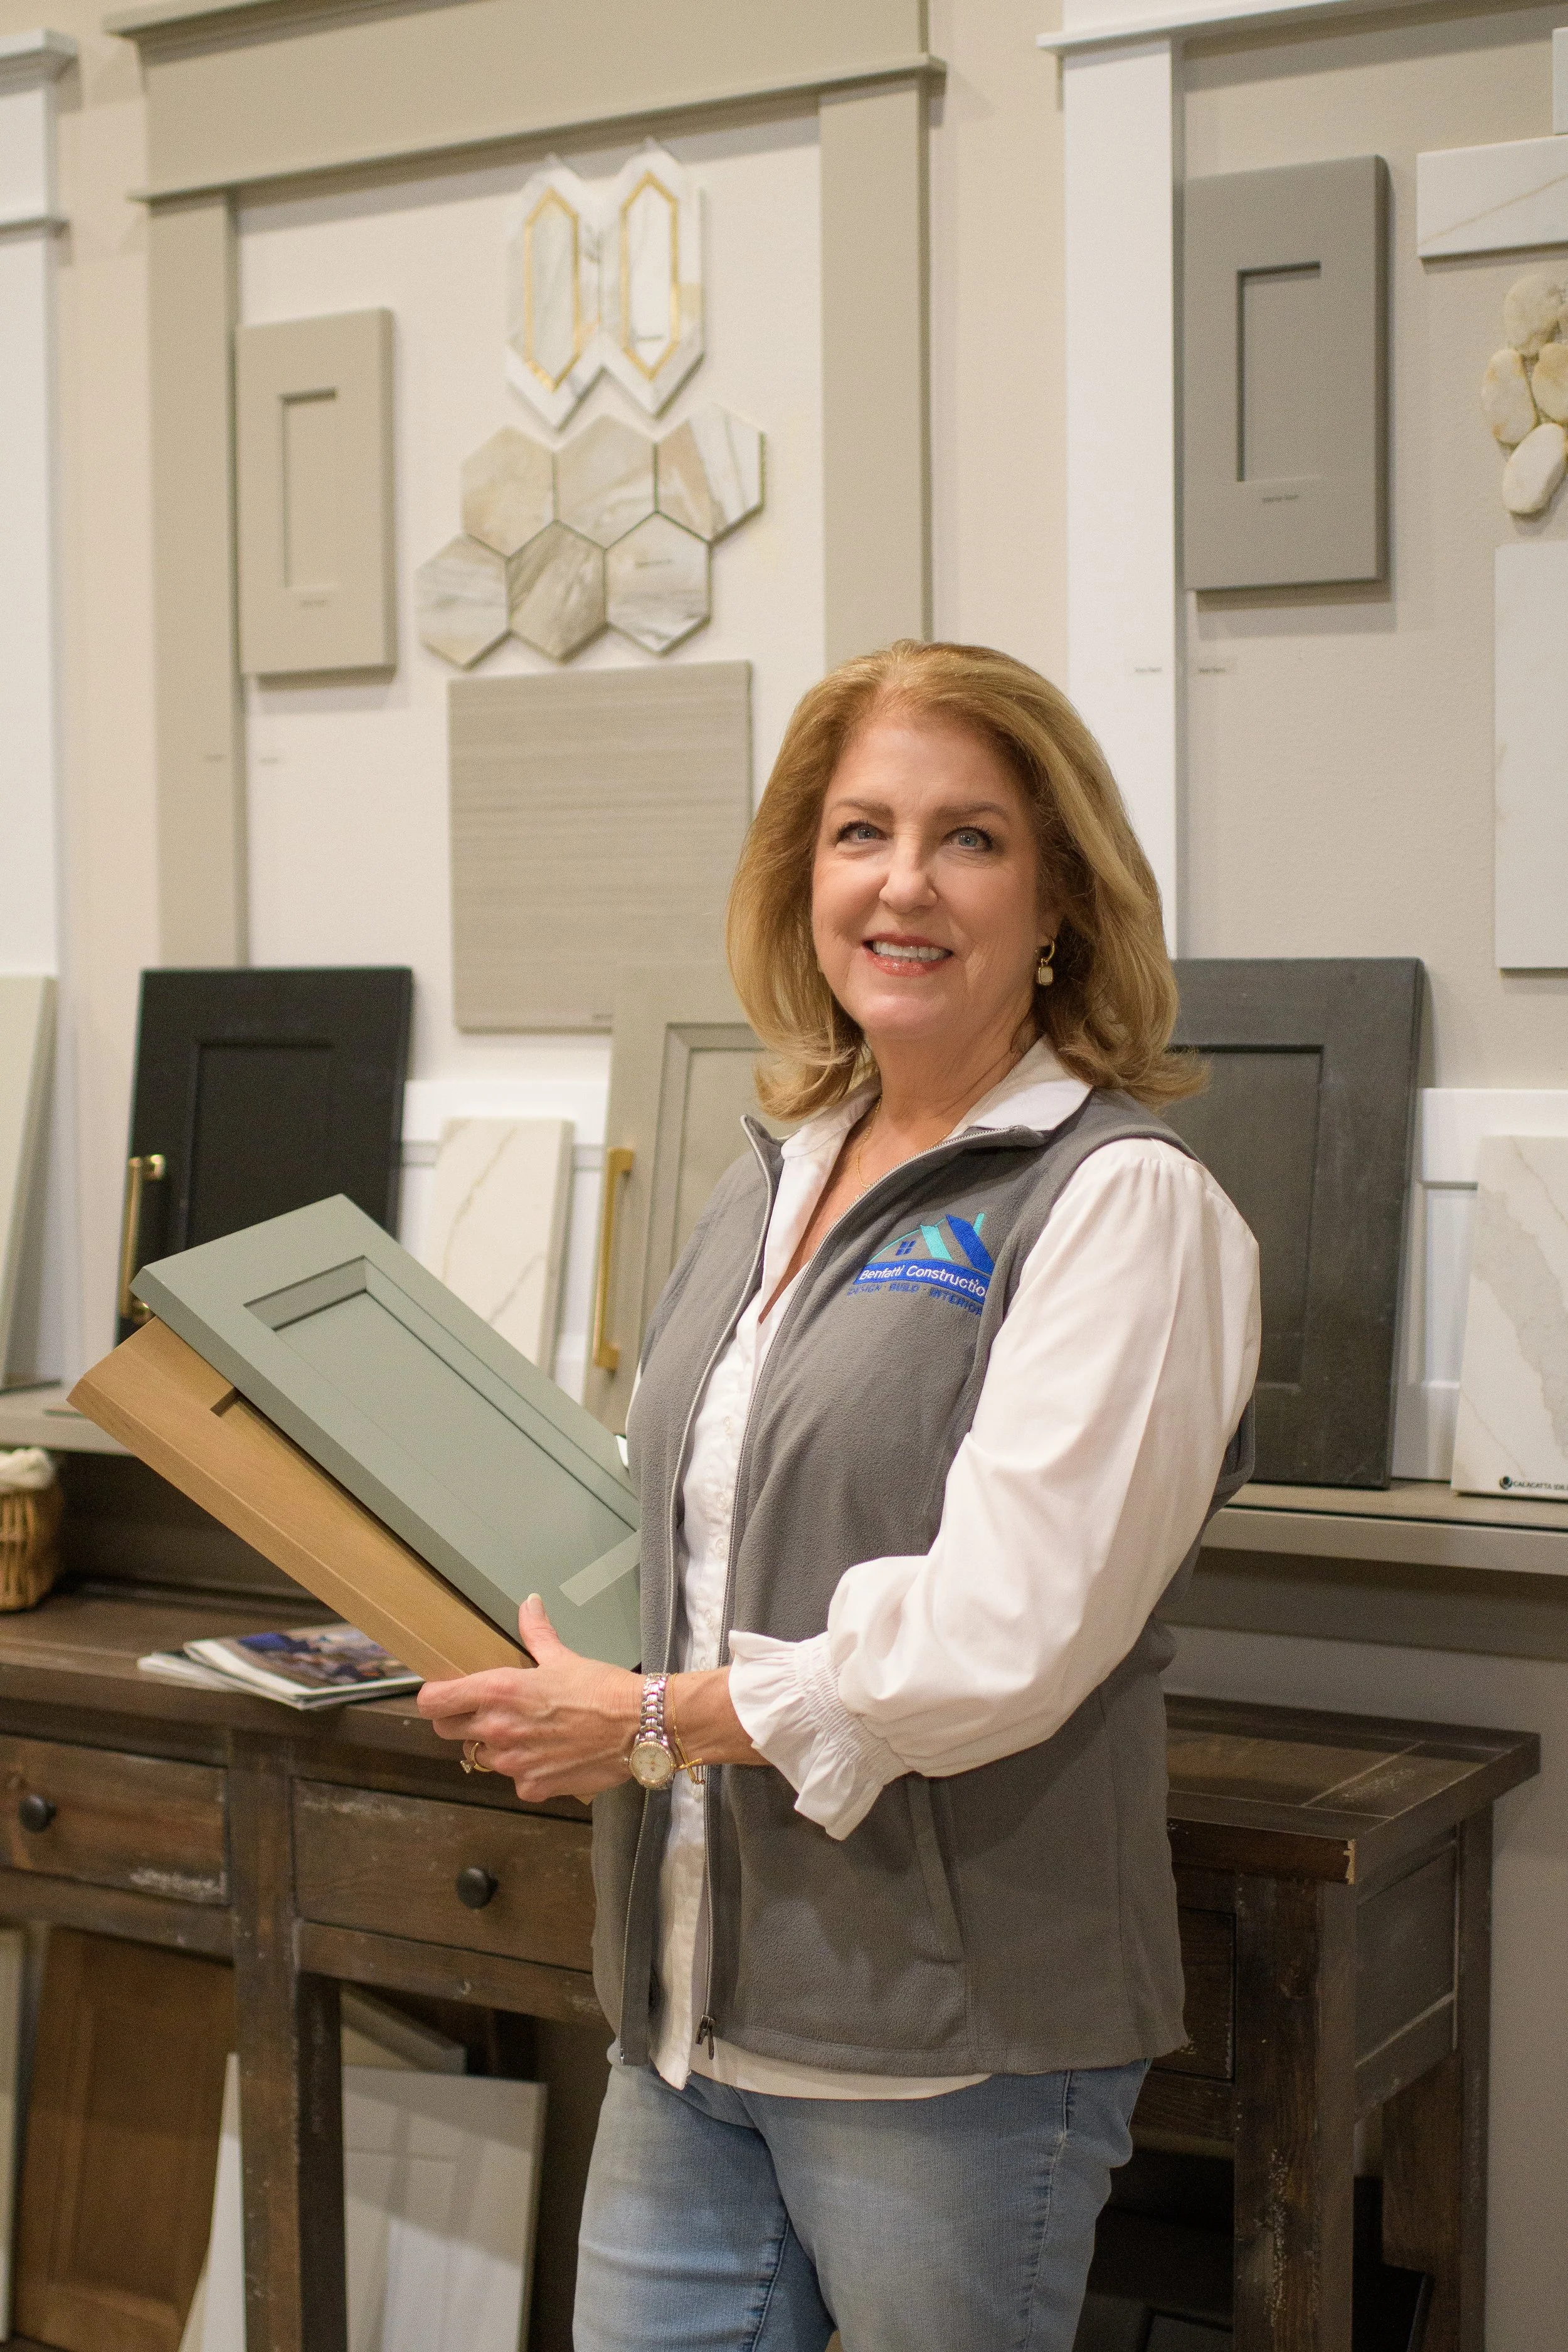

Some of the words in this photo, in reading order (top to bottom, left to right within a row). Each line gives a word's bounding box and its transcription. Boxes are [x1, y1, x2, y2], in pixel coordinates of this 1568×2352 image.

[859, 1264, 904, 1279] Benfatti
[906, 1266, 987, 1297] Constructio
[889, 1283, 920, 1294] BUILD
